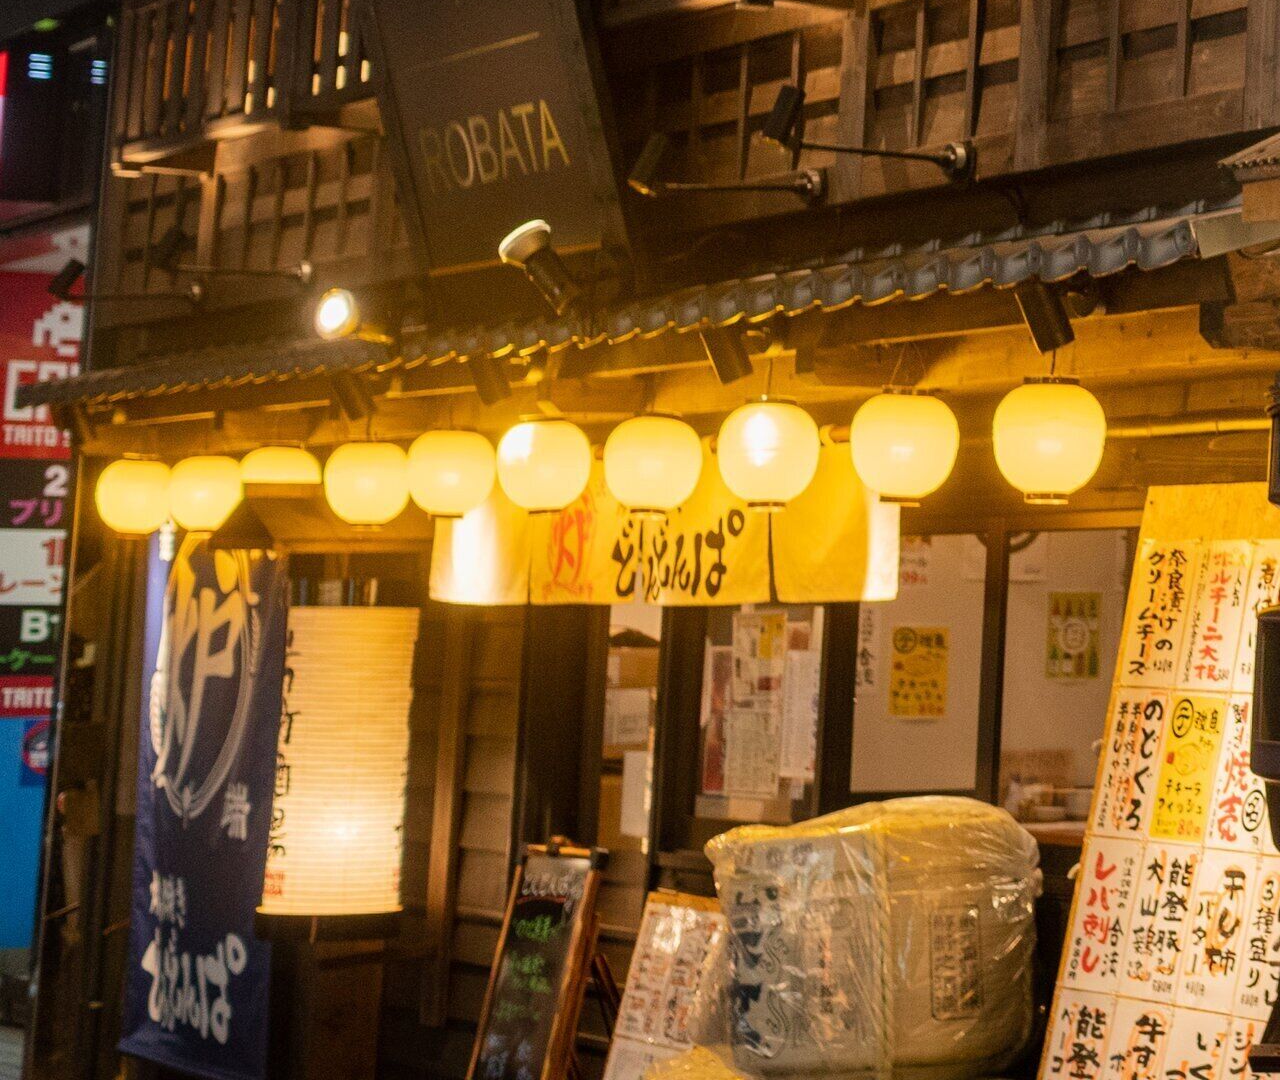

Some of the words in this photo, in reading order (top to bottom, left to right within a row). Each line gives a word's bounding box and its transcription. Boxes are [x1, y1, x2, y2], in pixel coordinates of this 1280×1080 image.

[418, 96, 570, 196] ROBATA
[1125, 699, 1164, 832] のどぐろ
[1081, 851, 1117, 974] レバ刺し
